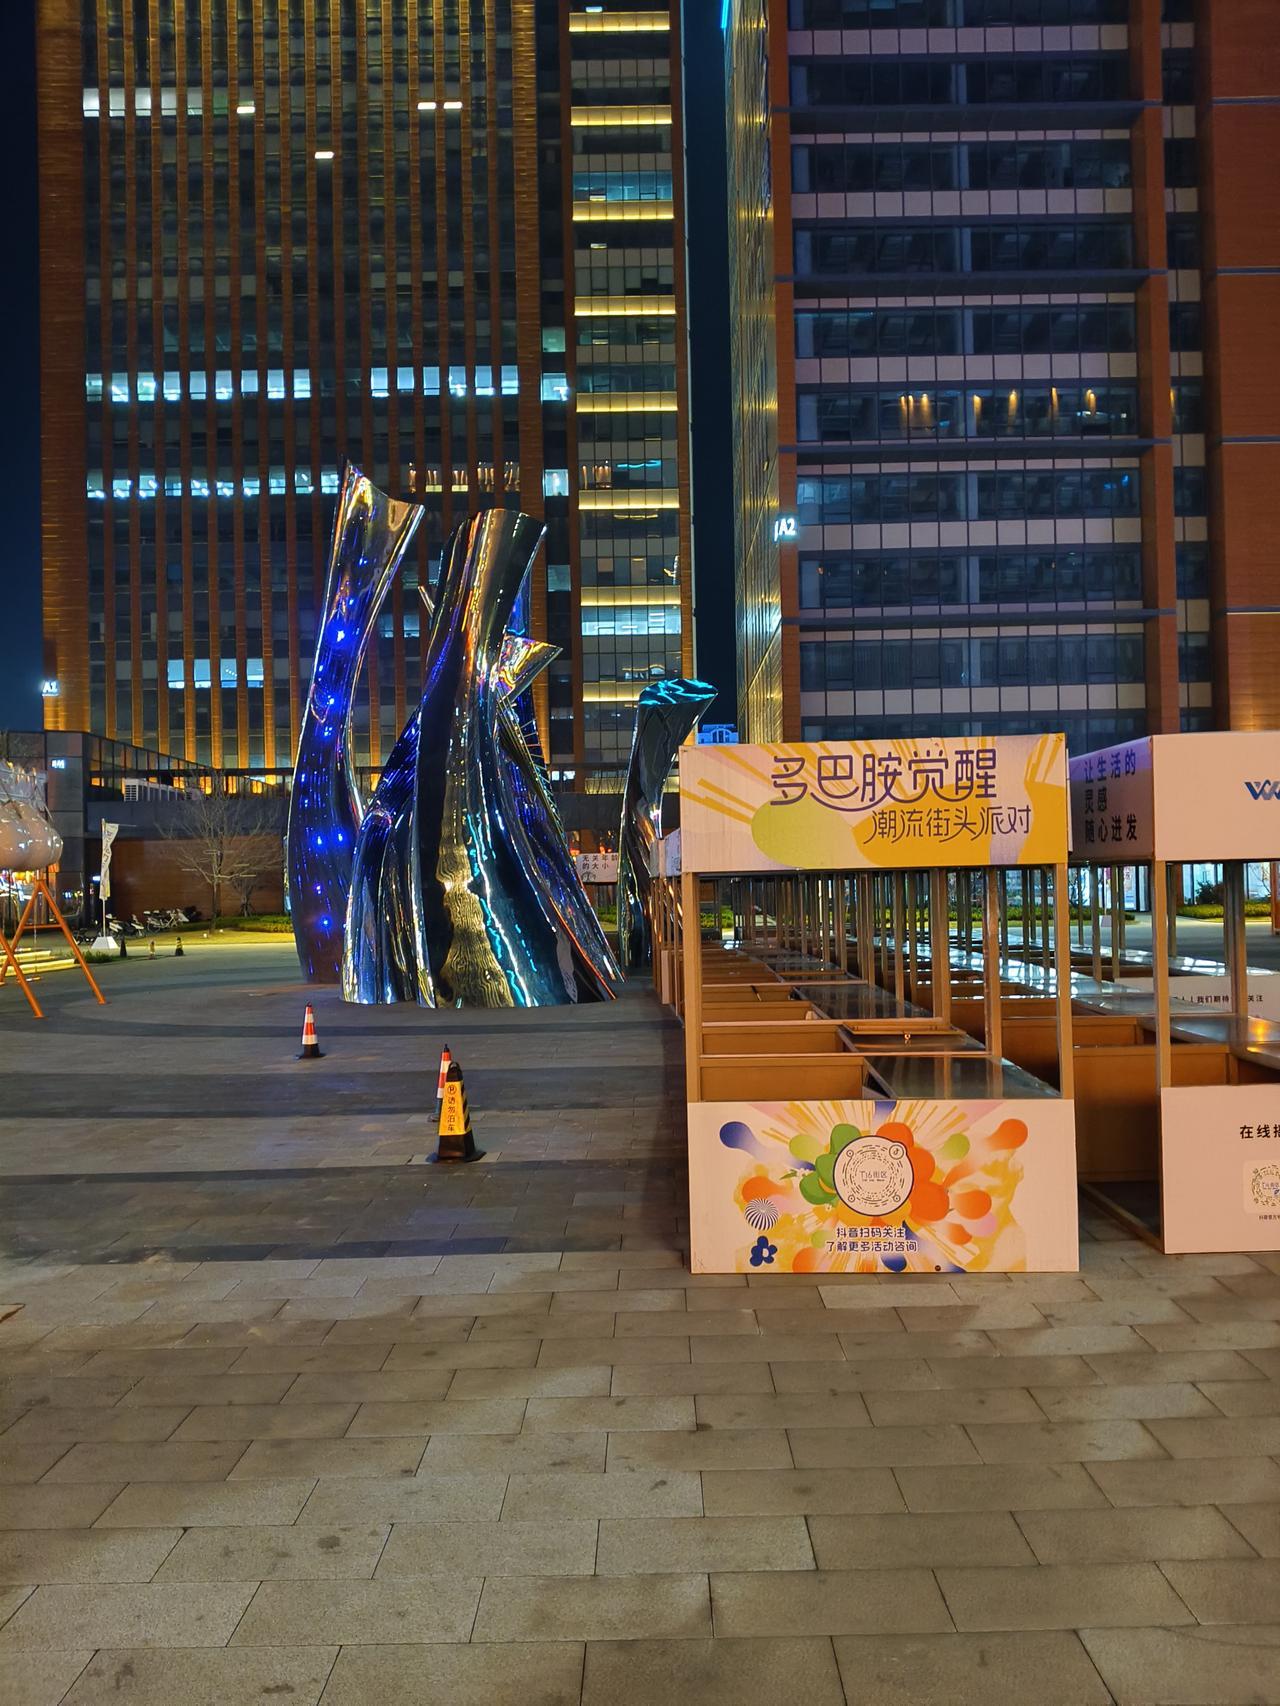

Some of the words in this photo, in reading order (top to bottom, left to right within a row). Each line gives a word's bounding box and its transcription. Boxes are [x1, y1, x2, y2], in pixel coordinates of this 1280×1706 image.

[779, 518, 796, 536] A2
[43, 682, 58, 693] A1
[1084, 750, 1136, 784] 让生活的
[770, 748, 997, 812] 多巴胺觉醒
[1084, 787, 1108, 814] 灵感
[864, 805, 1032, 844] 潮流街头派对
[836, 1226, 906, 1238] 抖音扫码关注
[826, 1241, 918, 1252] 了解更多活动咨询
